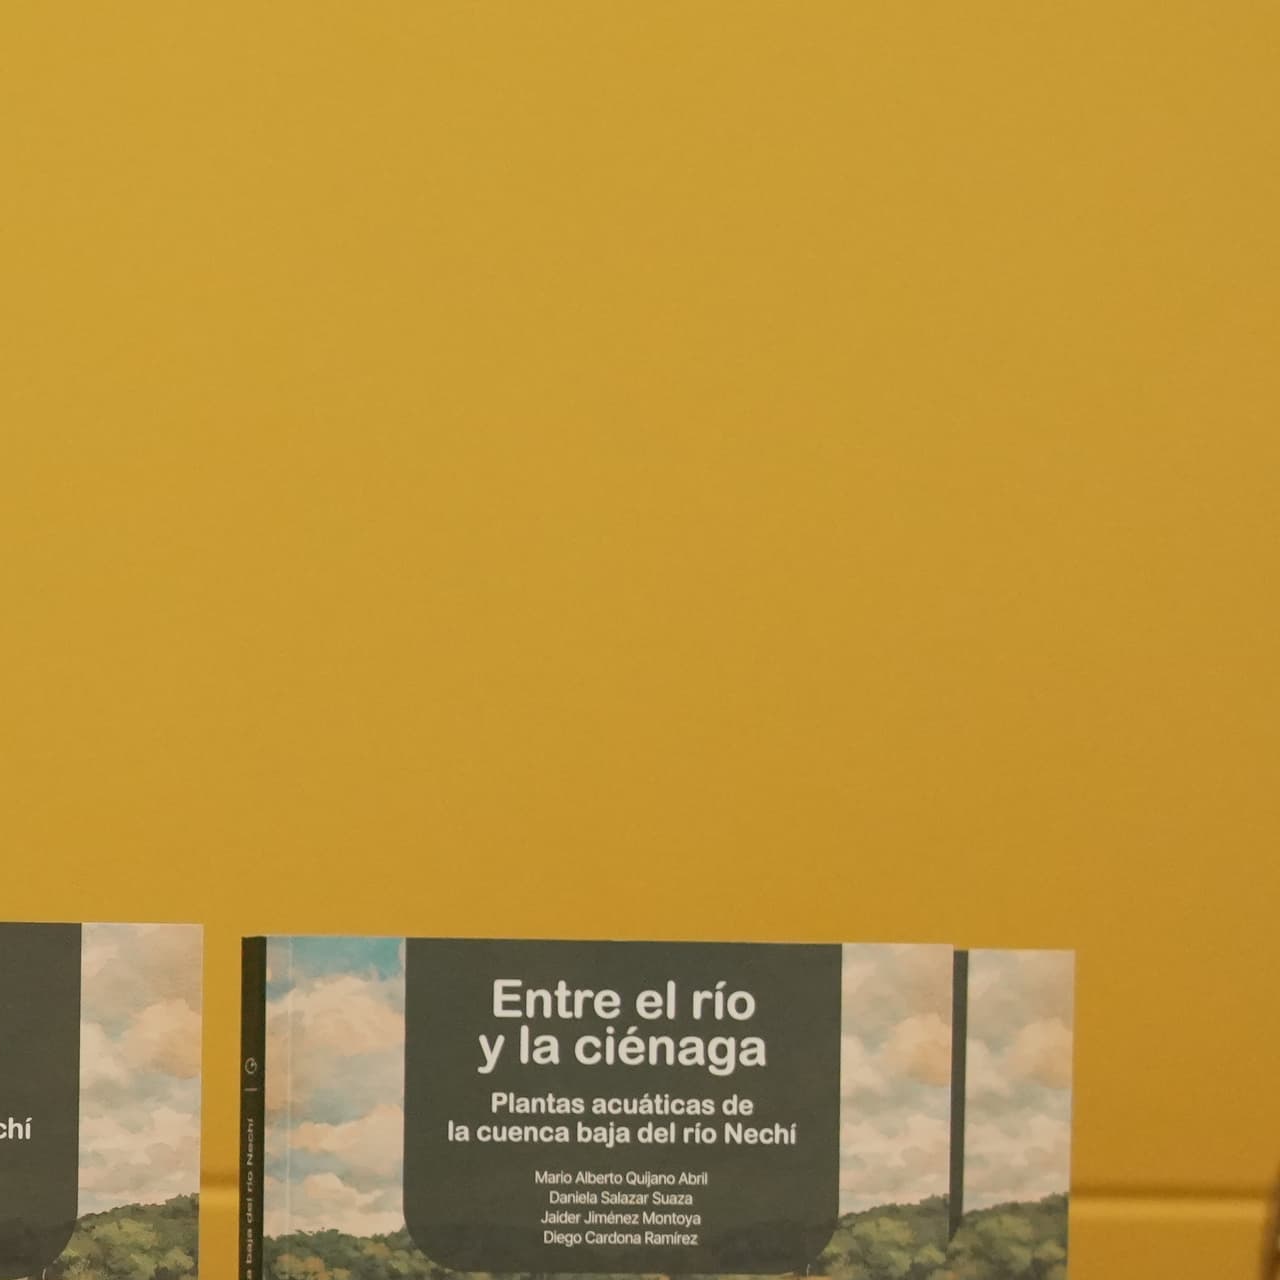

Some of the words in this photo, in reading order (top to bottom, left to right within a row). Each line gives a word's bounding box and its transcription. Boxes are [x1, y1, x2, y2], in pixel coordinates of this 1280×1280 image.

[493, 978, 621, 1020] Entre
[635, 979, 676, 1020] el
[692, 980, 756, 1021] río
[477, 1034, 506, 1074] y
[519, 1024, 560, 1065] la
[574, 1025, 767, 1077] ciénaga
[491, 1091, 585, 1115] Plantas
[591, 1092, 716, 1116] acuáticas
[721, 1093, 754, 1116] de
[447, 1119, 470, 1142] la
[476, 1125, 570, 1143] cuenca
[576, 1121, 631, 1149] baja
[637, 1121, 676, 1144] del
[683, 1122, 718, 1144] río
[724, 1122, 797, 1145] Nechí
[534, 1170, 573, 1185] Mario
[574, 1170, 624, 1185] Alberto
[625, 1170, 676, 1188] Quijano
[678, 1171, 708, 1186] Abril
[549, 1190, 598, 1205] Daniela
[600, 1190, 650, 1205] Salazar
[652, 1190, 694, 1206] Suaza
[540, 1210, 582, 1225] Jaider
[583, 1210, 640, 1225] Jiménez
[642, 1210, 702, 1228] Montoya
[543, 1230, 583, 1248] Diego
[584, 1230, 642, 1245] Cardona
[644, 1230, 699, 1246] Ramírez
